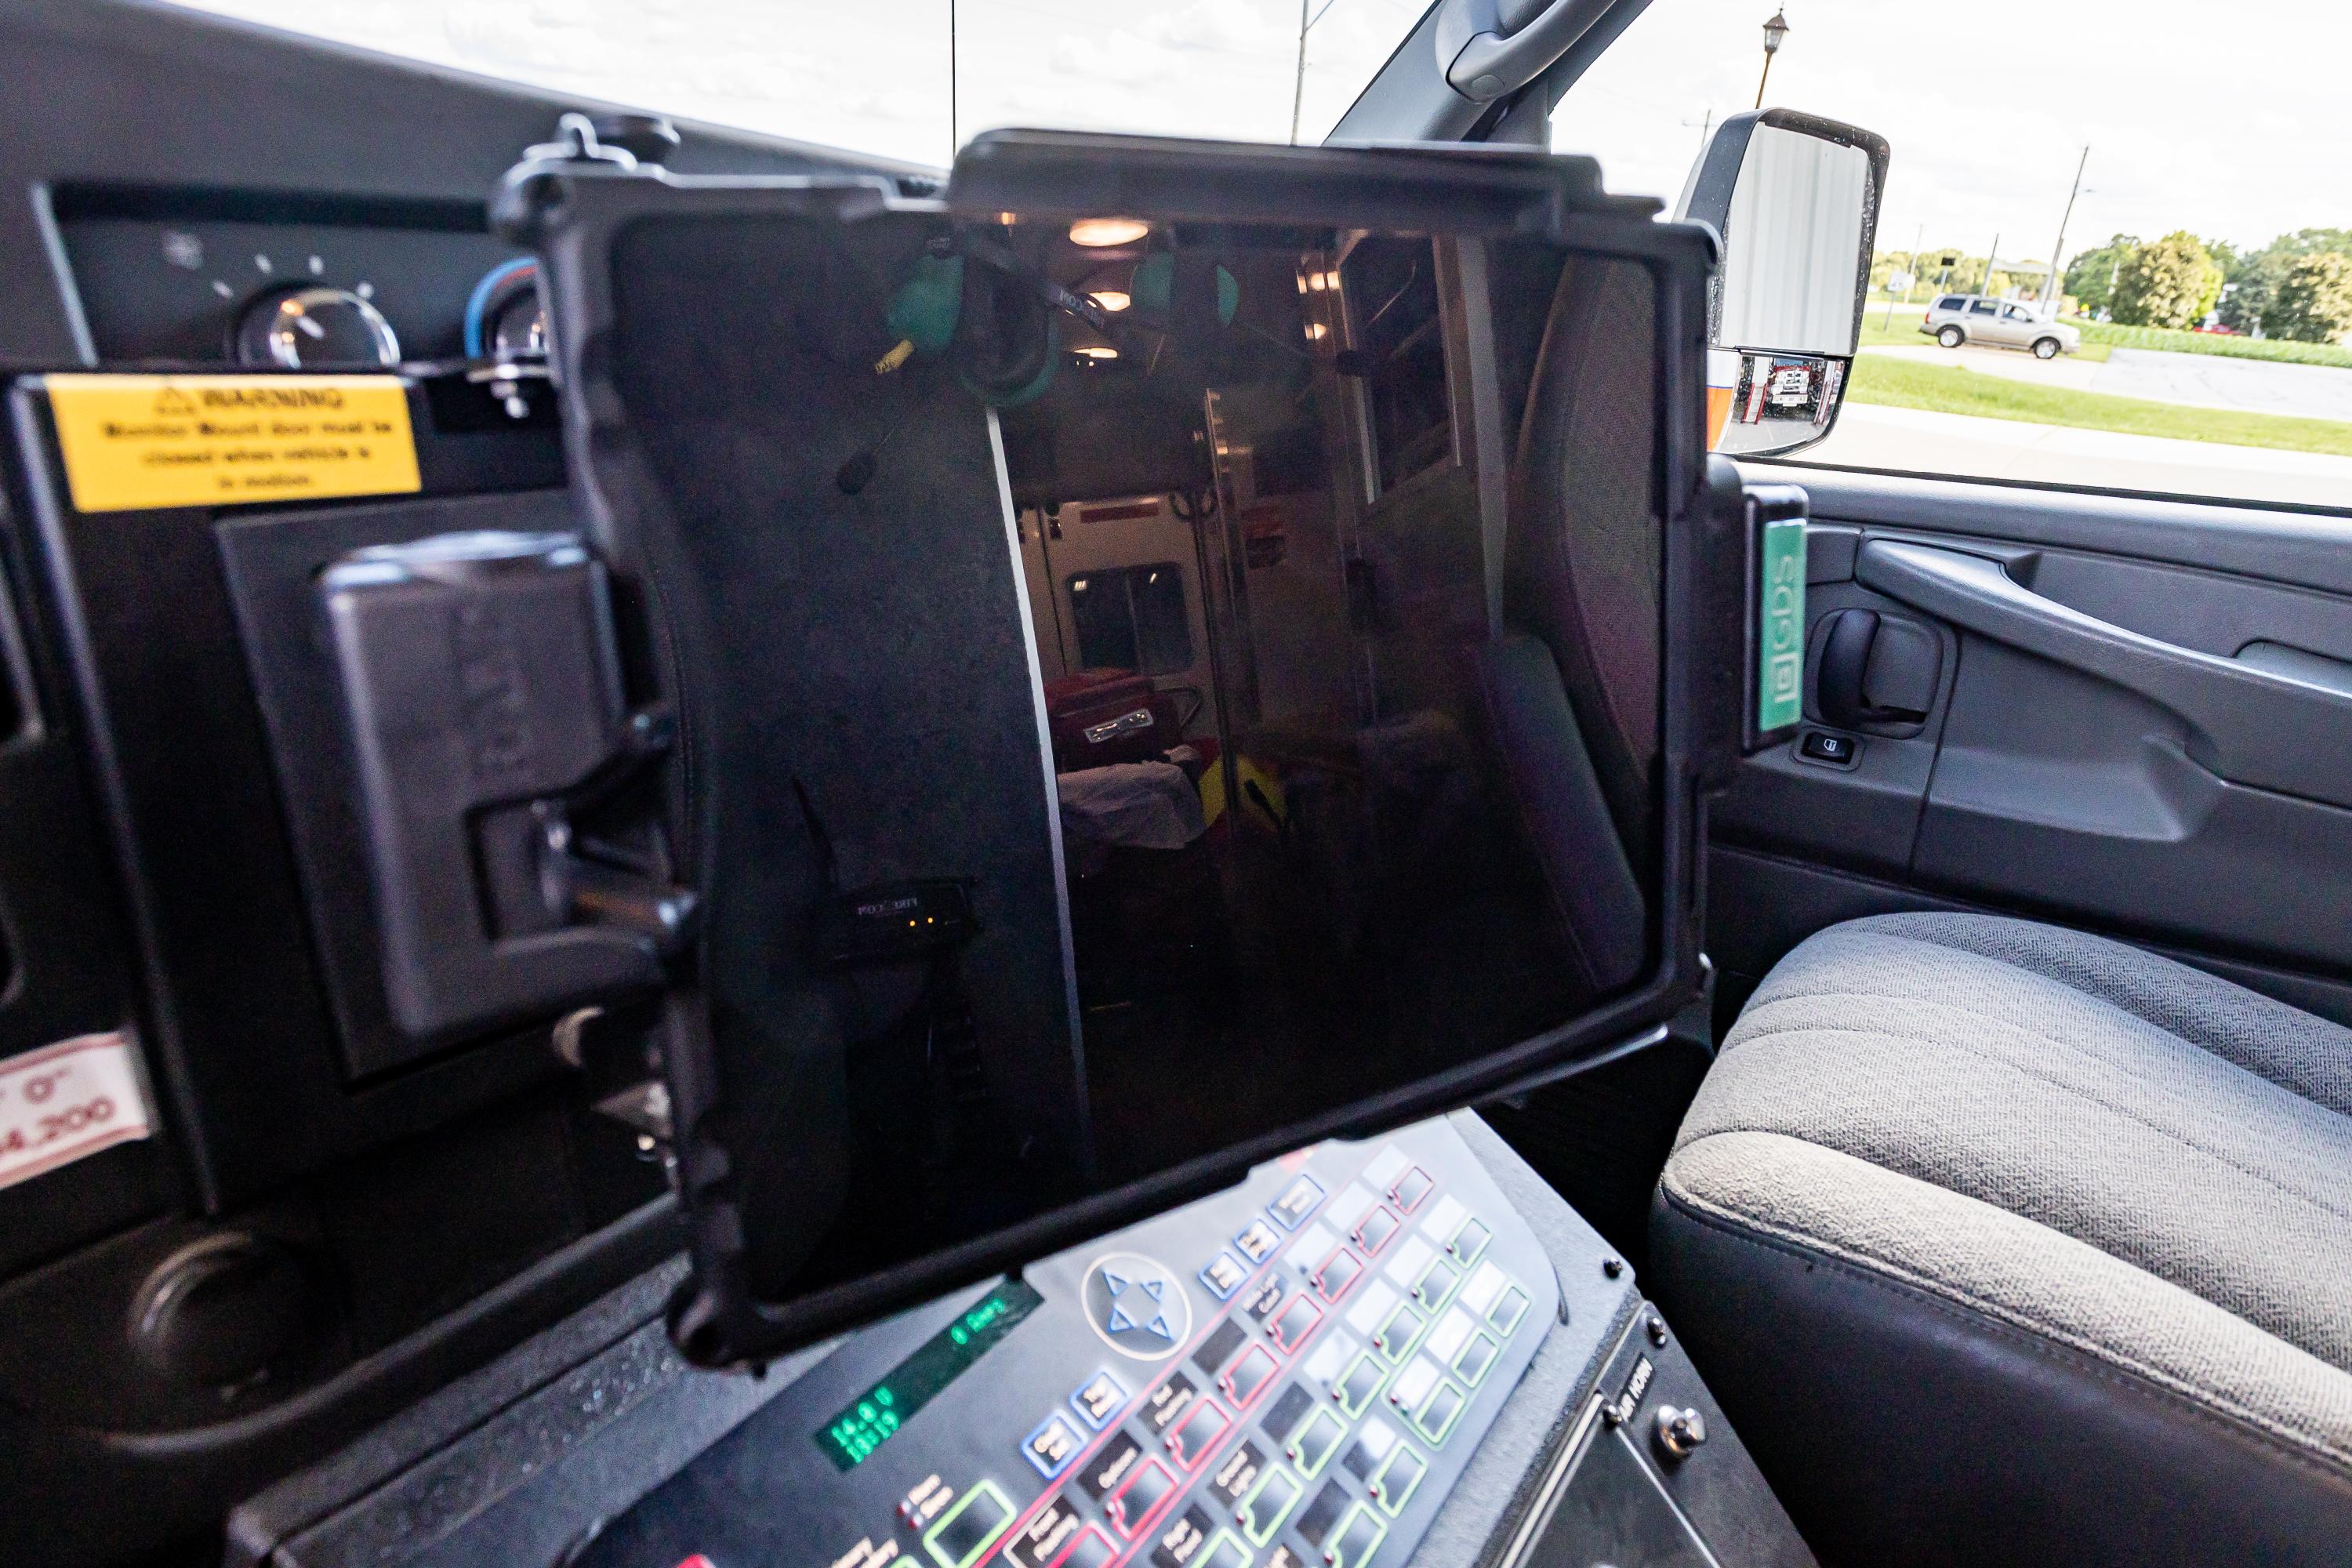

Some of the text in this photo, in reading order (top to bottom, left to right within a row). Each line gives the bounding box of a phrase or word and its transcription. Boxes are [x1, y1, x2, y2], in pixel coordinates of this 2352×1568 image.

[205, 387, 343, 410] WARNING
[1770, 555, 1794, 652] GDS
[1618, 1357, 1653, 1423] AIR HORN
